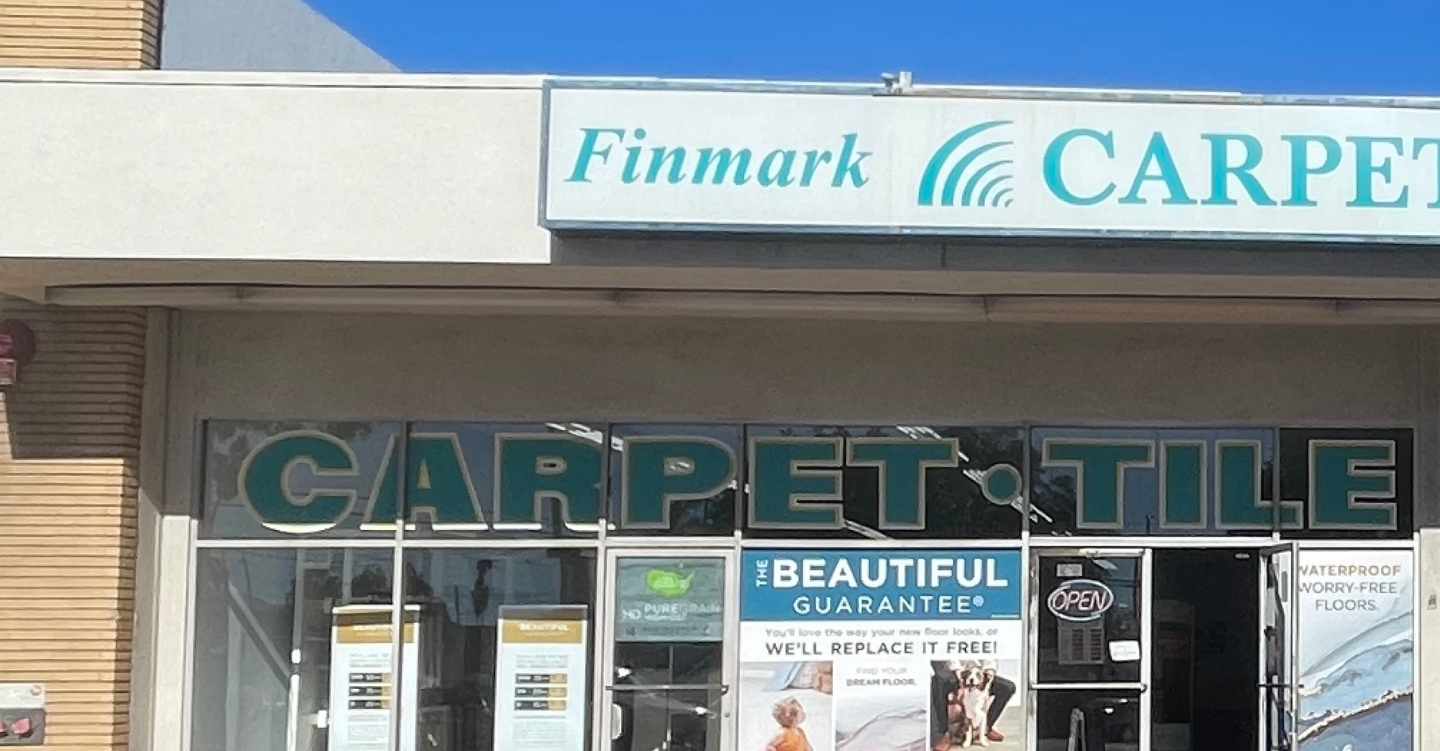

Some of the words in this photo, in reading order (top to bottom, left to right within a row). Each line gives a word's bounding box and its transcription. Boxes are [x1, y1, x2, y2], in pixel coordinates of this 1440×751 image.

[563, 126, 872, 189] Finmark
[236, 429, 960, 534] CARPET
[1041, 437, 1399, 532] TILE
[756, 559, 769, 588] THE
[773, 557, 1009, 588] BEAUTIFUL
[1052, 589, 1108, 612] OPEN
[765, 628, 796, 638] You'll
[798, 628, 822, 637] love
[825, 628, 844, 637] the
[846, 629, 868, 638] way
[871, 628, 896, 638] your
[899, 628, 921, 637] new
[924, 626, 950, 636] floor
[765, 642, 823, 656] WE'LL
[831, 641, 915, 656] REPLACE
[922, 641, 939, 655] IT
[946, 641, 998, 655] FREE!
[846, 678, 881, 687] DREAM
